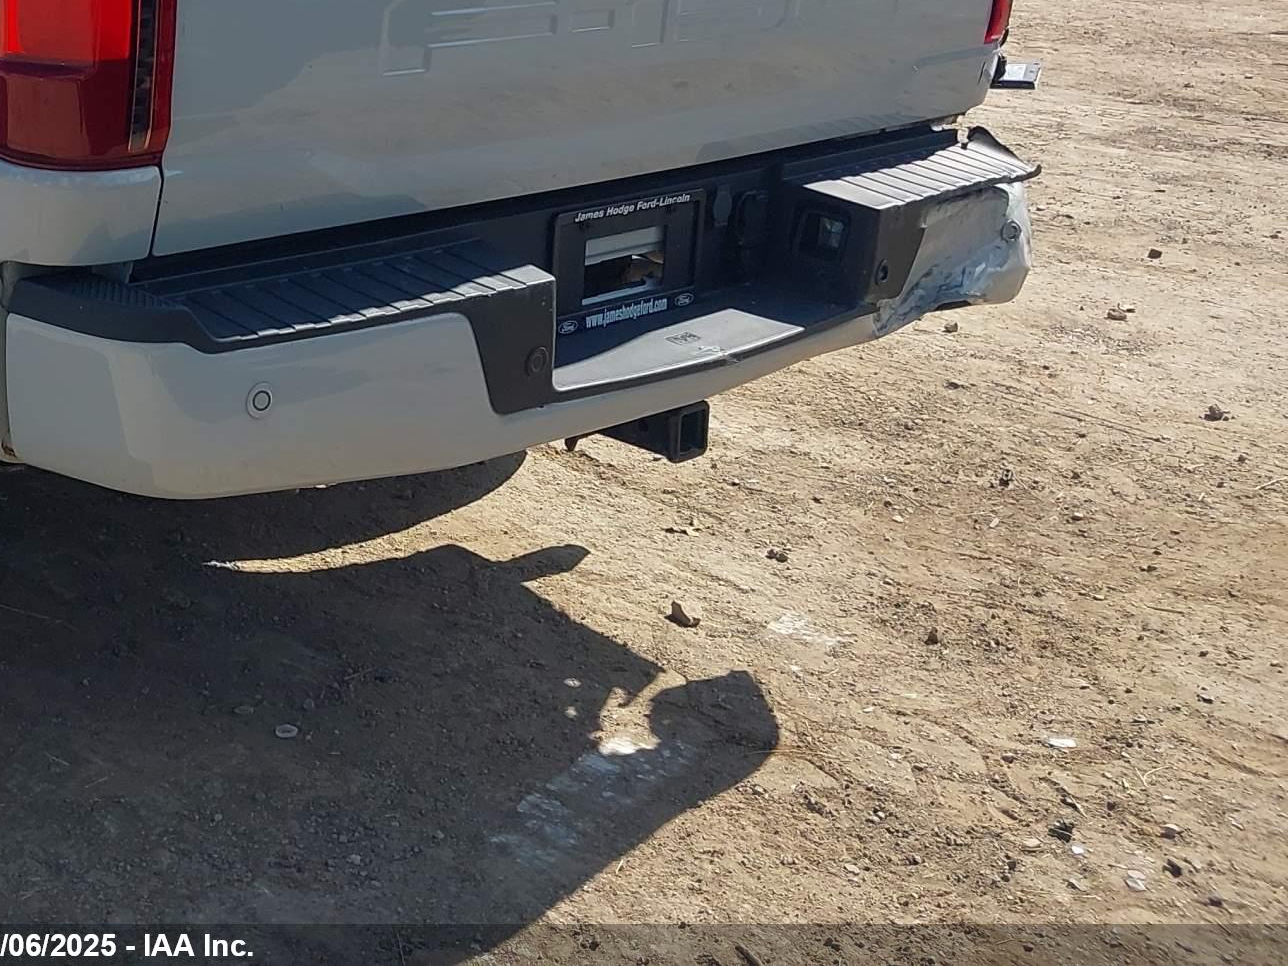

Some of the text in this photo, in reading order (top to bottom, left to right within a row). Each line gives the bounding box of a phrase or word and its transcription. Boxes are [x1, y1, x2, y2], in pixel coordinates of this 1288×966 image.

[574, 193, 691, 223] James Hodge Ford-Lincoln
[585, 297, 668, 329] www.jameshodgeford.com
